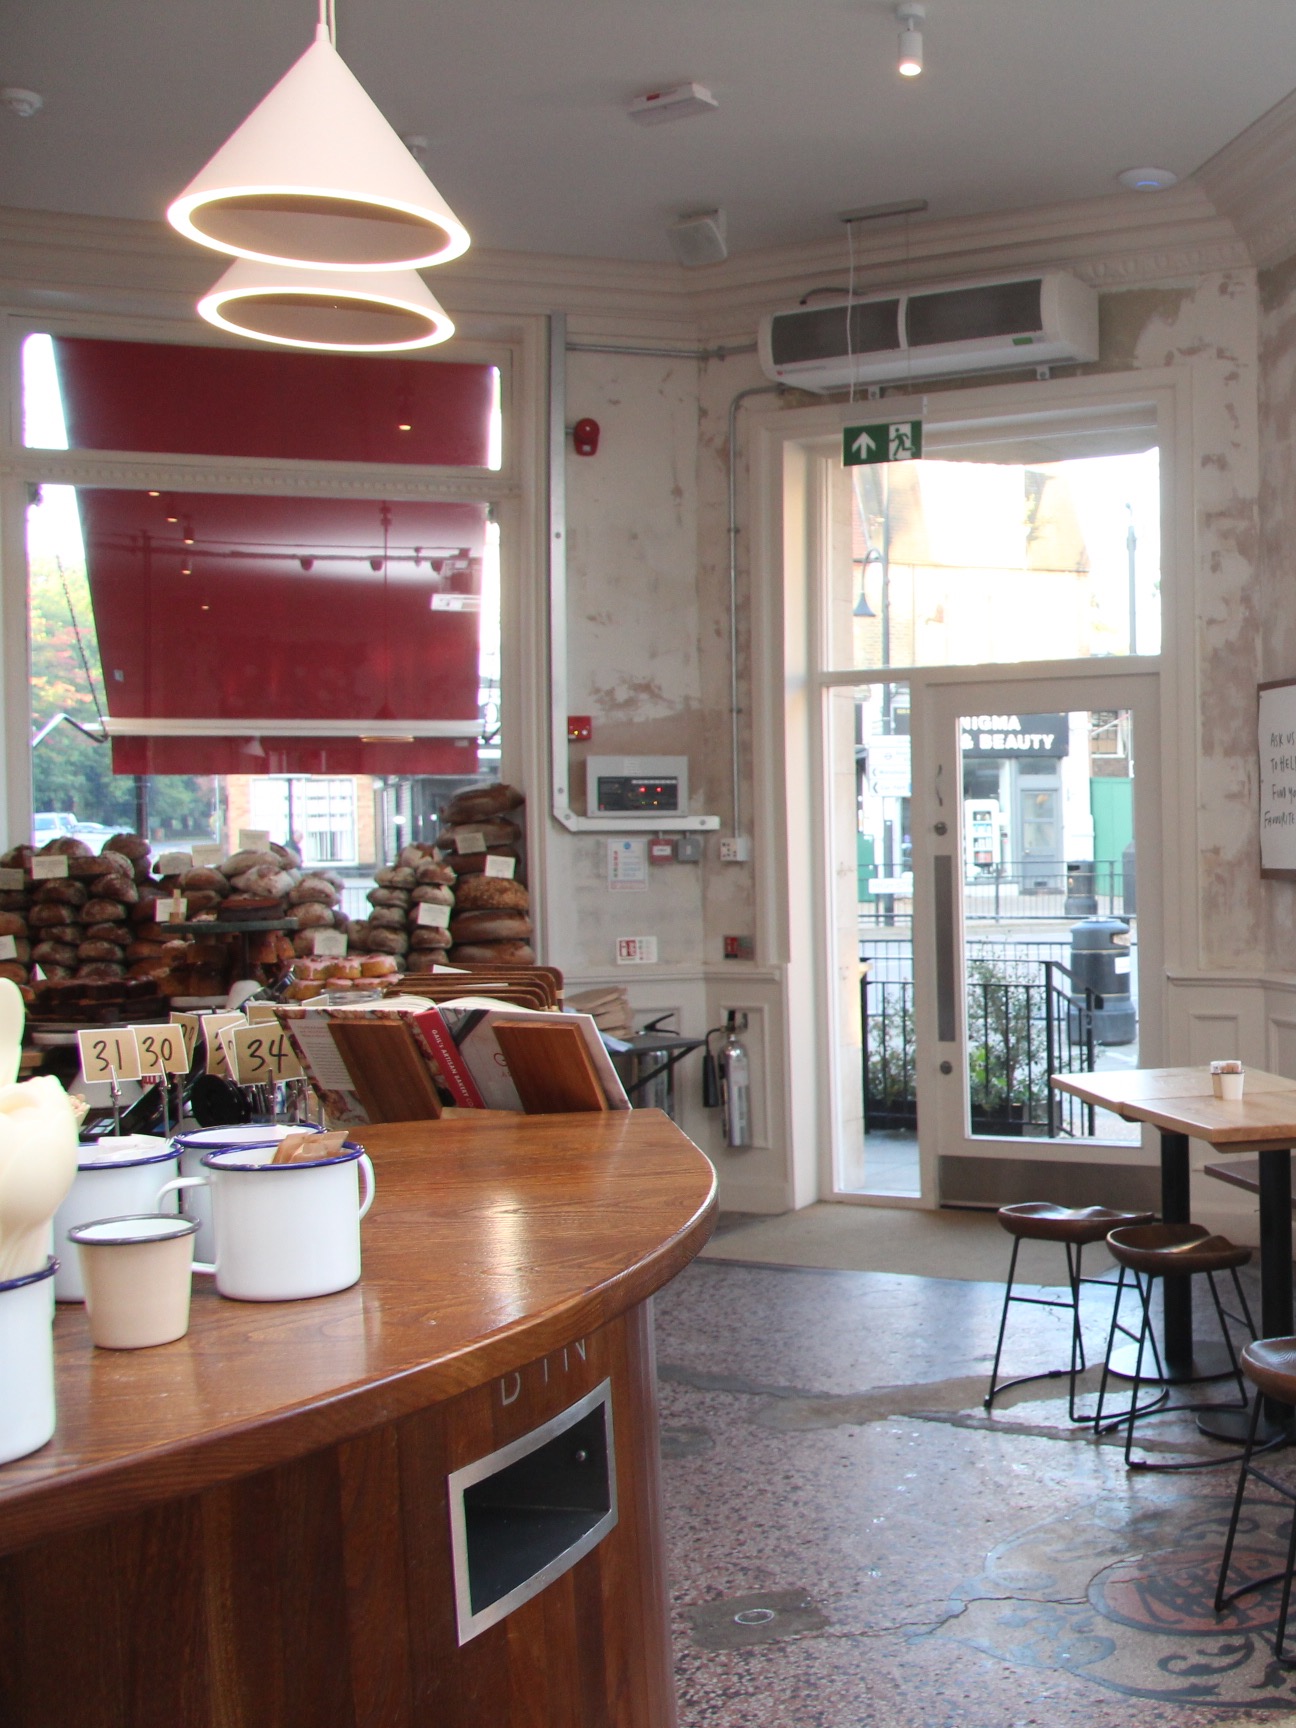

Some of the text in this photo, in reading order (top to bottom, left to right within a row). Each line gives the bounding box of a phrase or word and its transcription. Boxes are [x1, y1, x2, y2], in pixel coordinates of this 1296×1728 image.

[978, 733, 1055, 750] BEAUTY
[1270, 731, 1295, 747] ASK US
[92, 1039, 123, 1072] 31
[142, 1036, 173, 1067] 30
[247, 1034, 289, 1073] 34
[441, 1049, 458, 1074] ARTISAN
[454, 1075, 470, 1097] BAKERY
